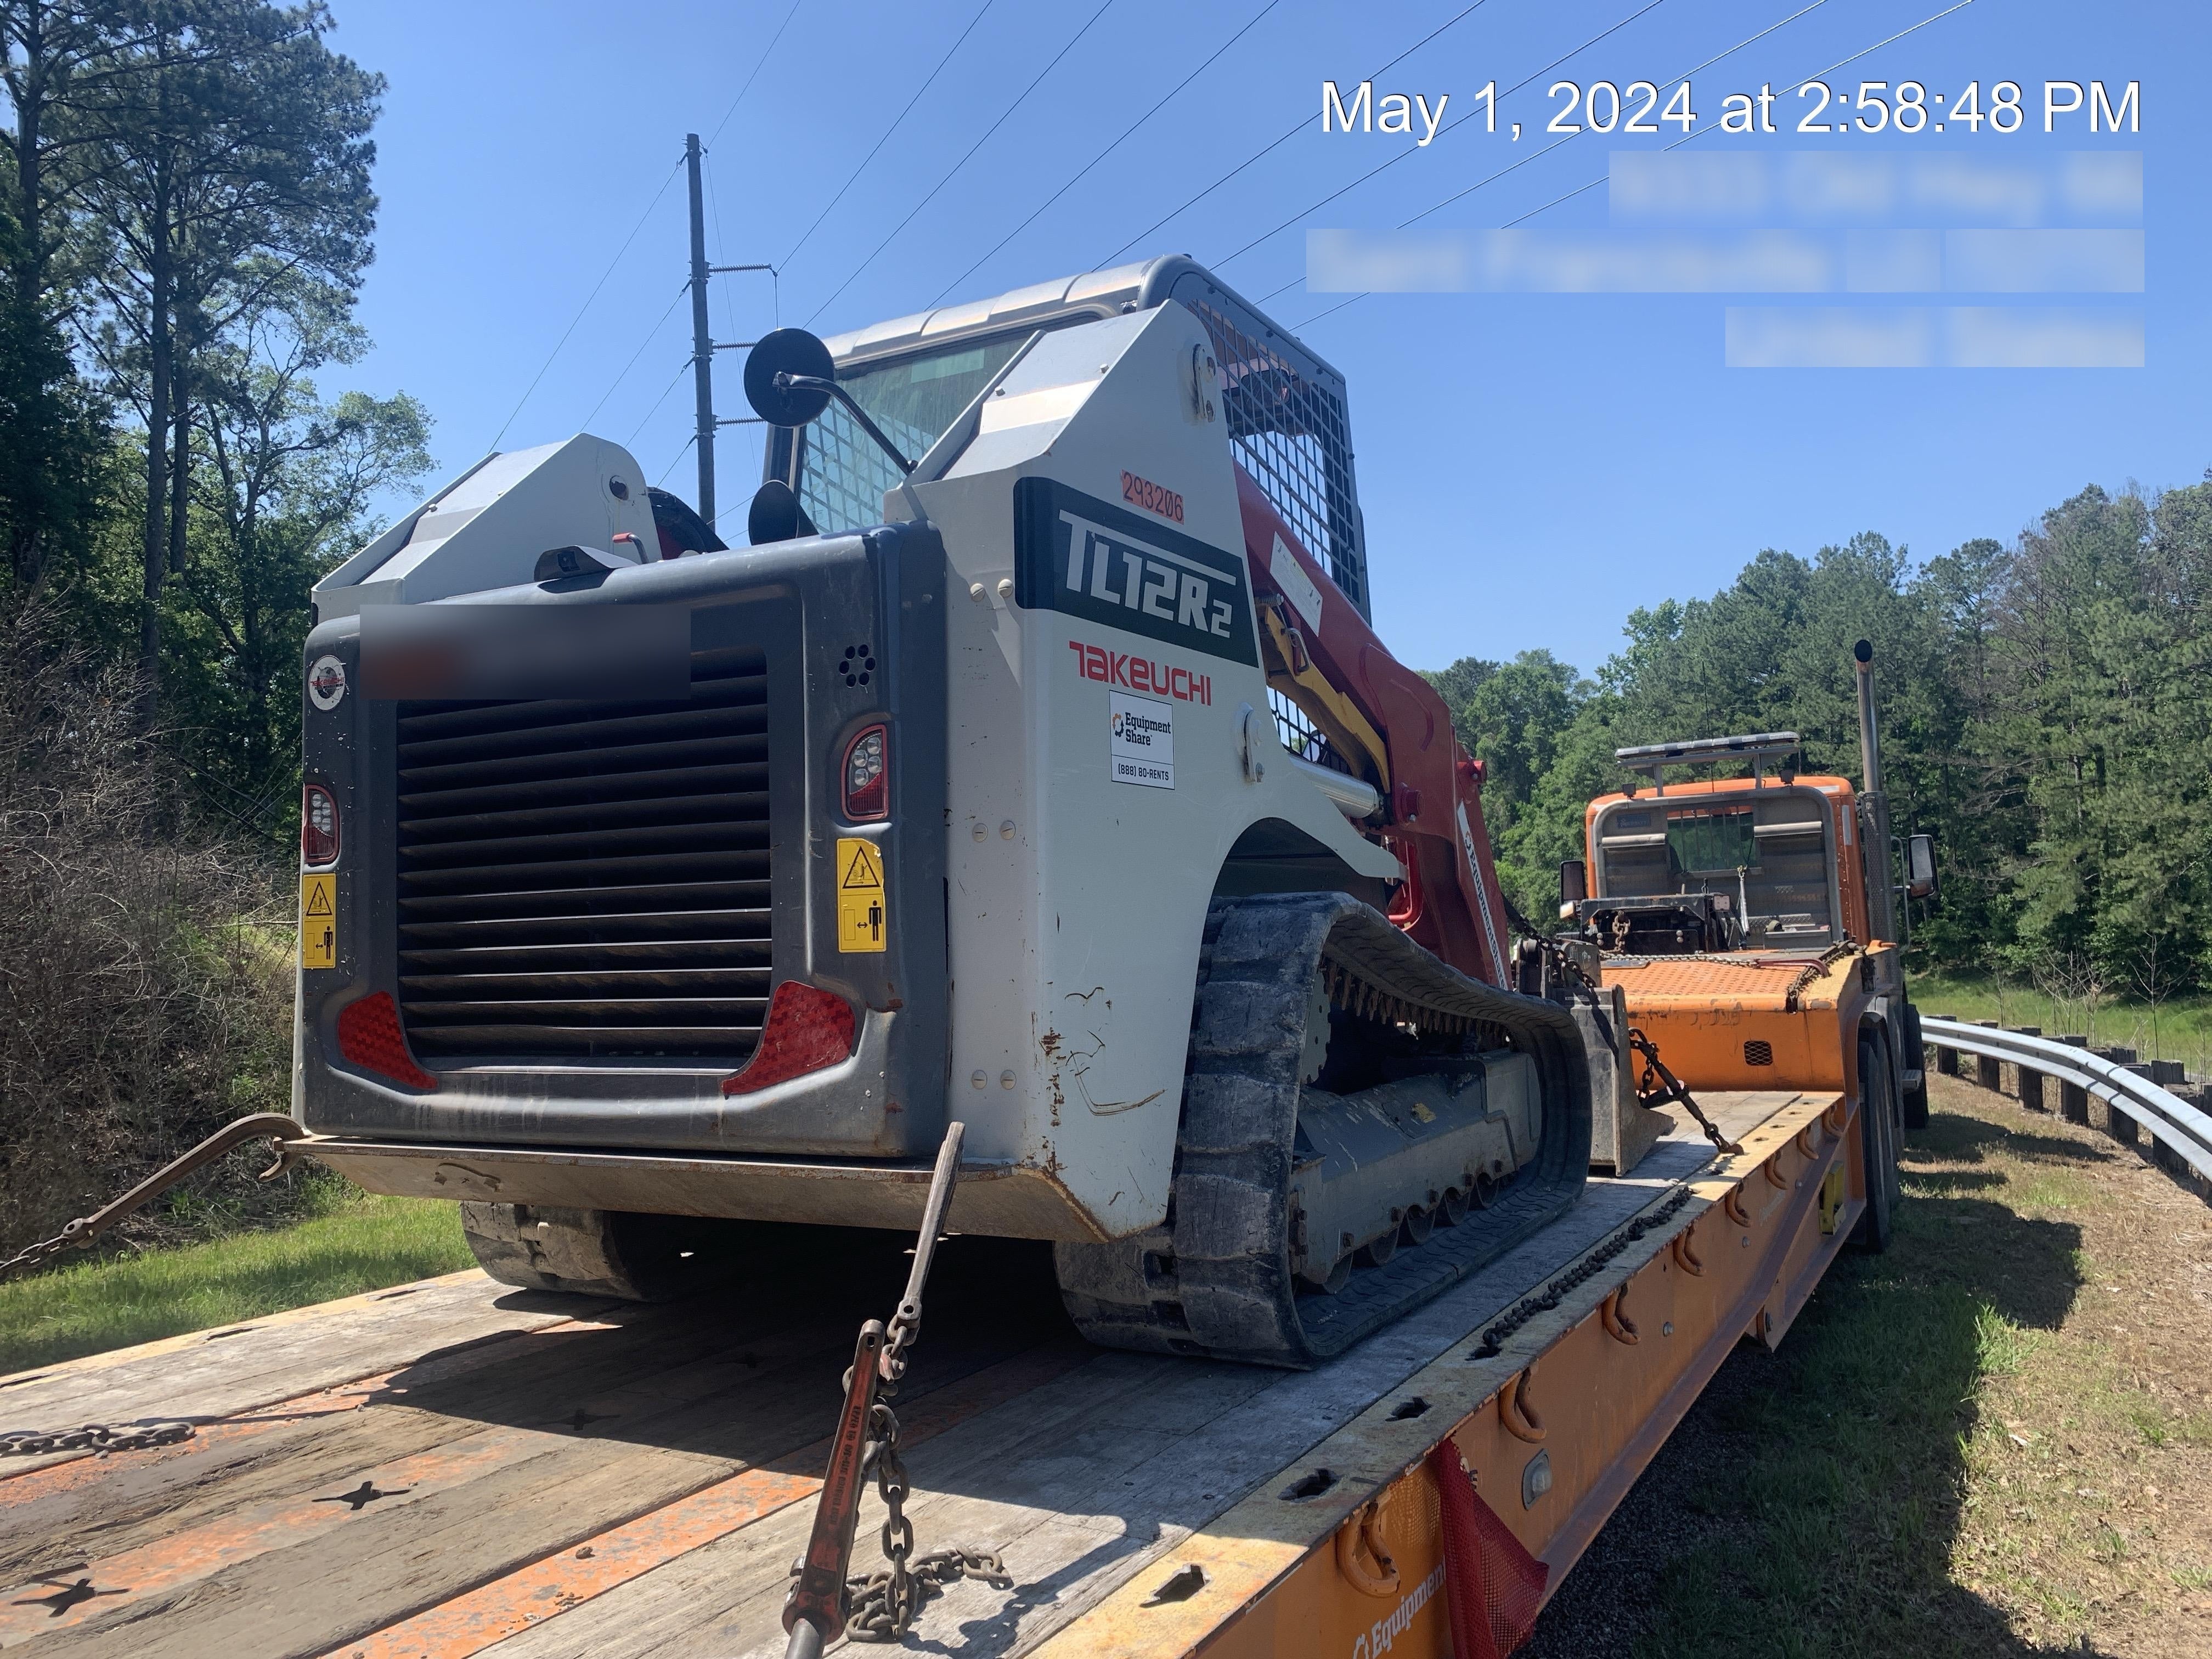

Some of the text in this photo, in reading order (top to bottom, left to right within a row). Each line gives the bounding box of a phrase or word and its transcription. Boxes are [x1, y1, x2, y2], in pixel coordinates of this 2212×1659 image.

[1123, 471, 1184, 522] 293206
[1125, 712, 1171, 734] Equipment
[1126, 729, 1151, 746] Share
[1118, 763, 1169, 781] (888) 80-RENTS
